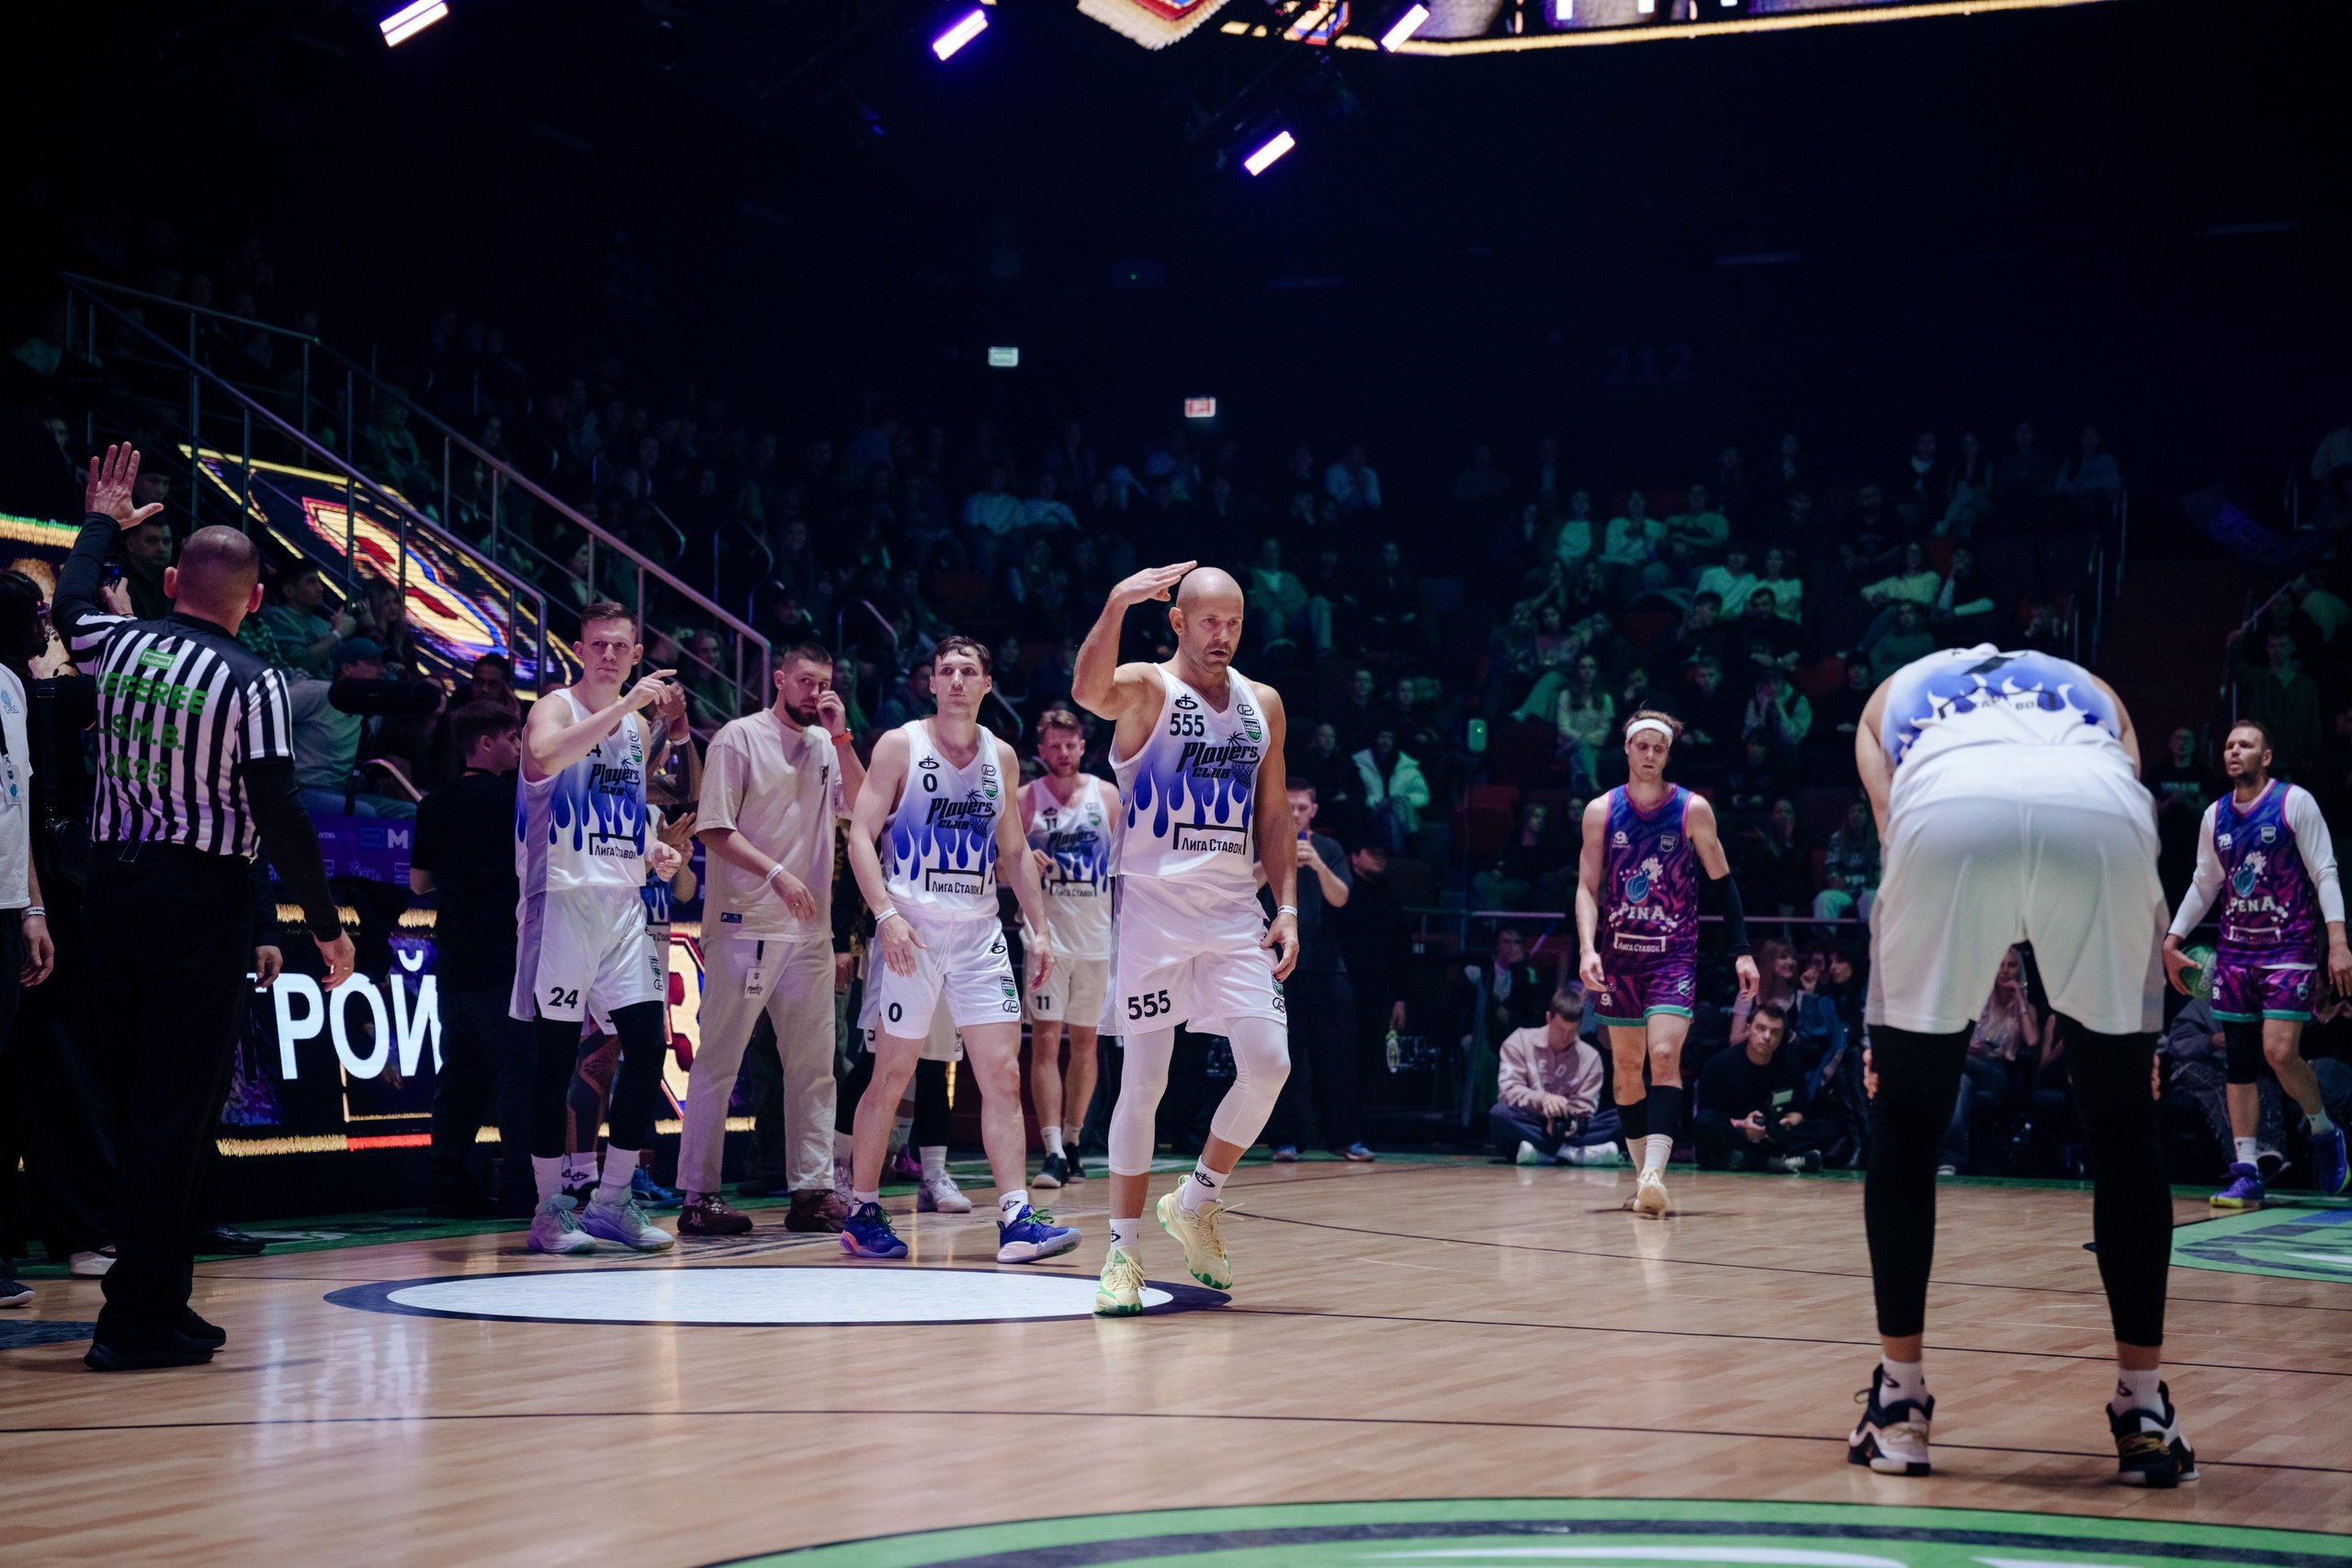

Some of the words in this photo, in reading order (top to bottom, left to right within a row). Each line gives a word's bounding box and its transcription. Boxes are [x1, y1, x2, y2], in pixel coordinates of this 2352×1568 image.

[1170, 713, 1204, 737] 555
[1176, 742, 1258, 773] Players
[106, 752, 168, 786] 2K25
[588, 764, 639, 791] Players
[1192, 767, 1231, 779] CLUB
[923, 773, 937, 793] 0
[926, 798, 993, 825] Players
[937, 818, 970, 829] CLUB
[1045, 818, 1057, 830] 11
[1622, 903, 1666, 920] PENA
[2231, 895, 2276, 913] PENA
[548, 987, 580, 1009] 24
[1036, 996, 1049, 1010] 11
[1128, 989, 1170, 1020] 555
[246, 950, 444, 1080] РОЙ
[888, 1002, 902, 1022] 0
